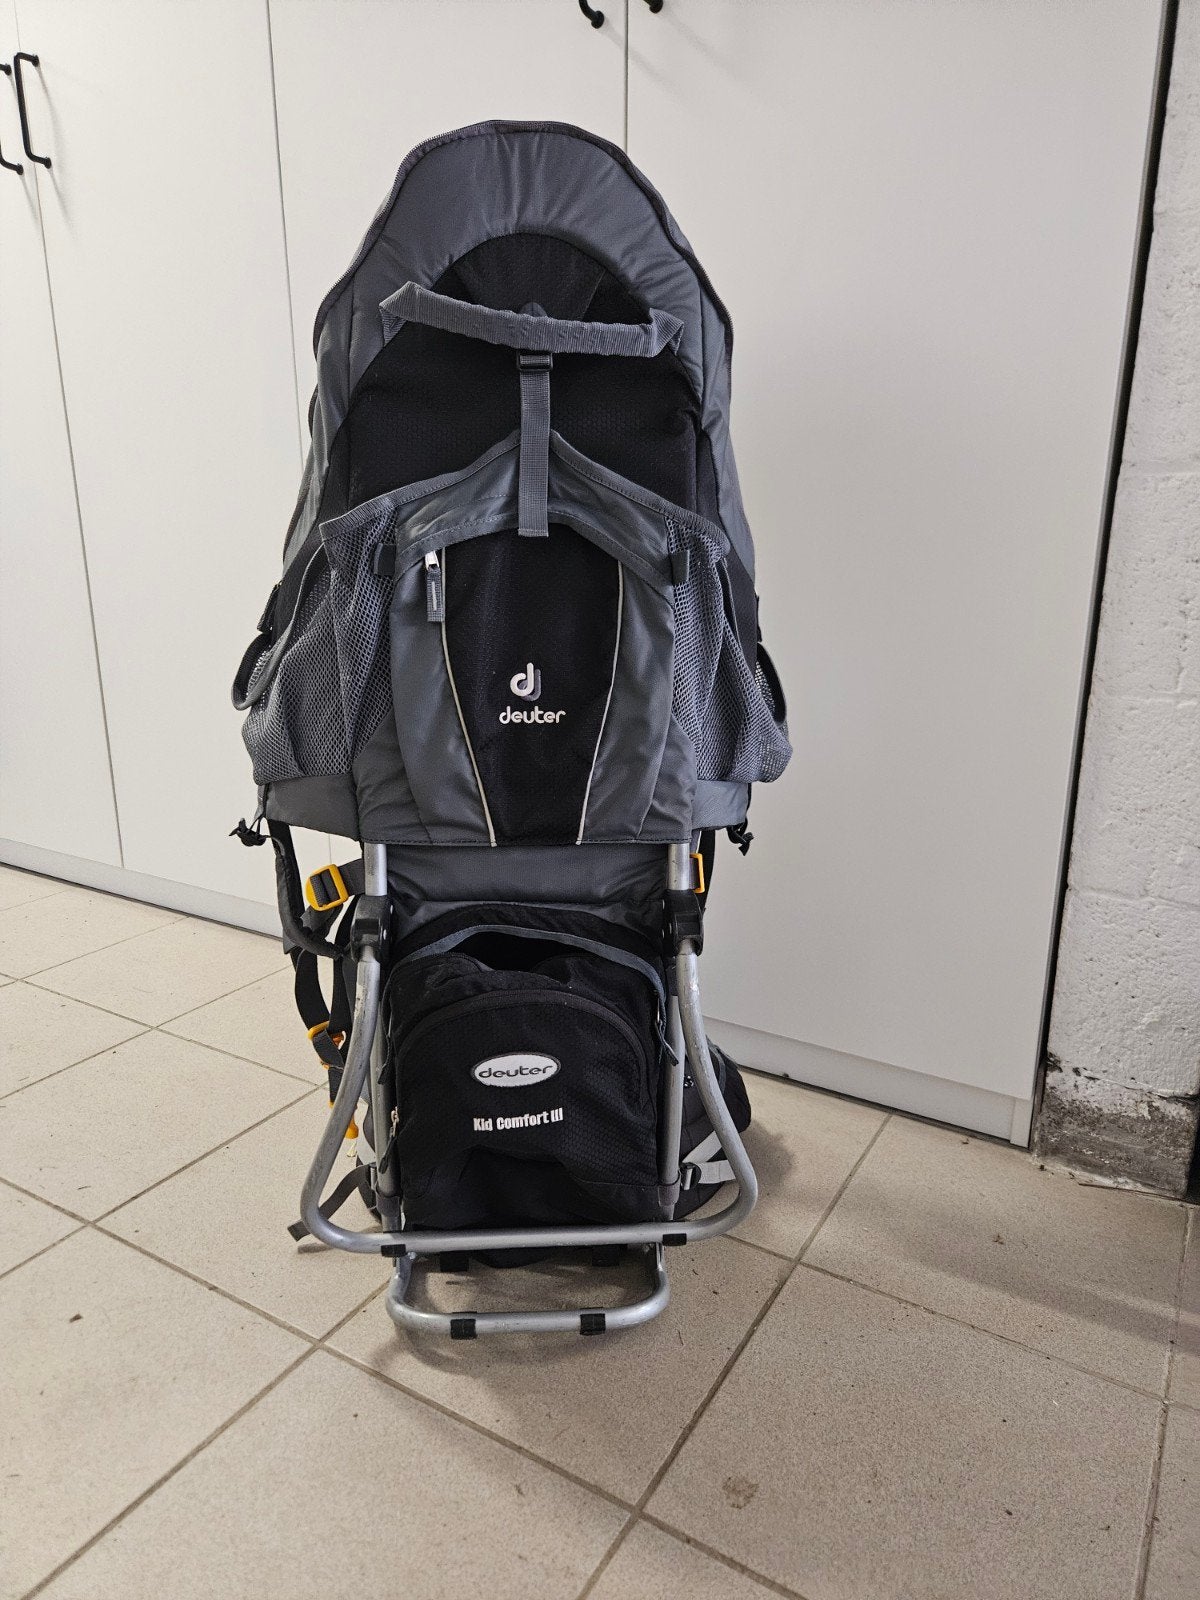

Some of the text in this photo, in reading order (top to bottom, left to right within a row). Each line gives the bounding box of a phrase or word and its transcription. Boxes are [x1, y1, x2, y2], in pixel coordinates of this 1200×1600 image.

[499, 705, 566, 724] deuter
[478, 1065, 553, 1078] deuter
[473, 1107, 564, 1131] Kid Comfort III
